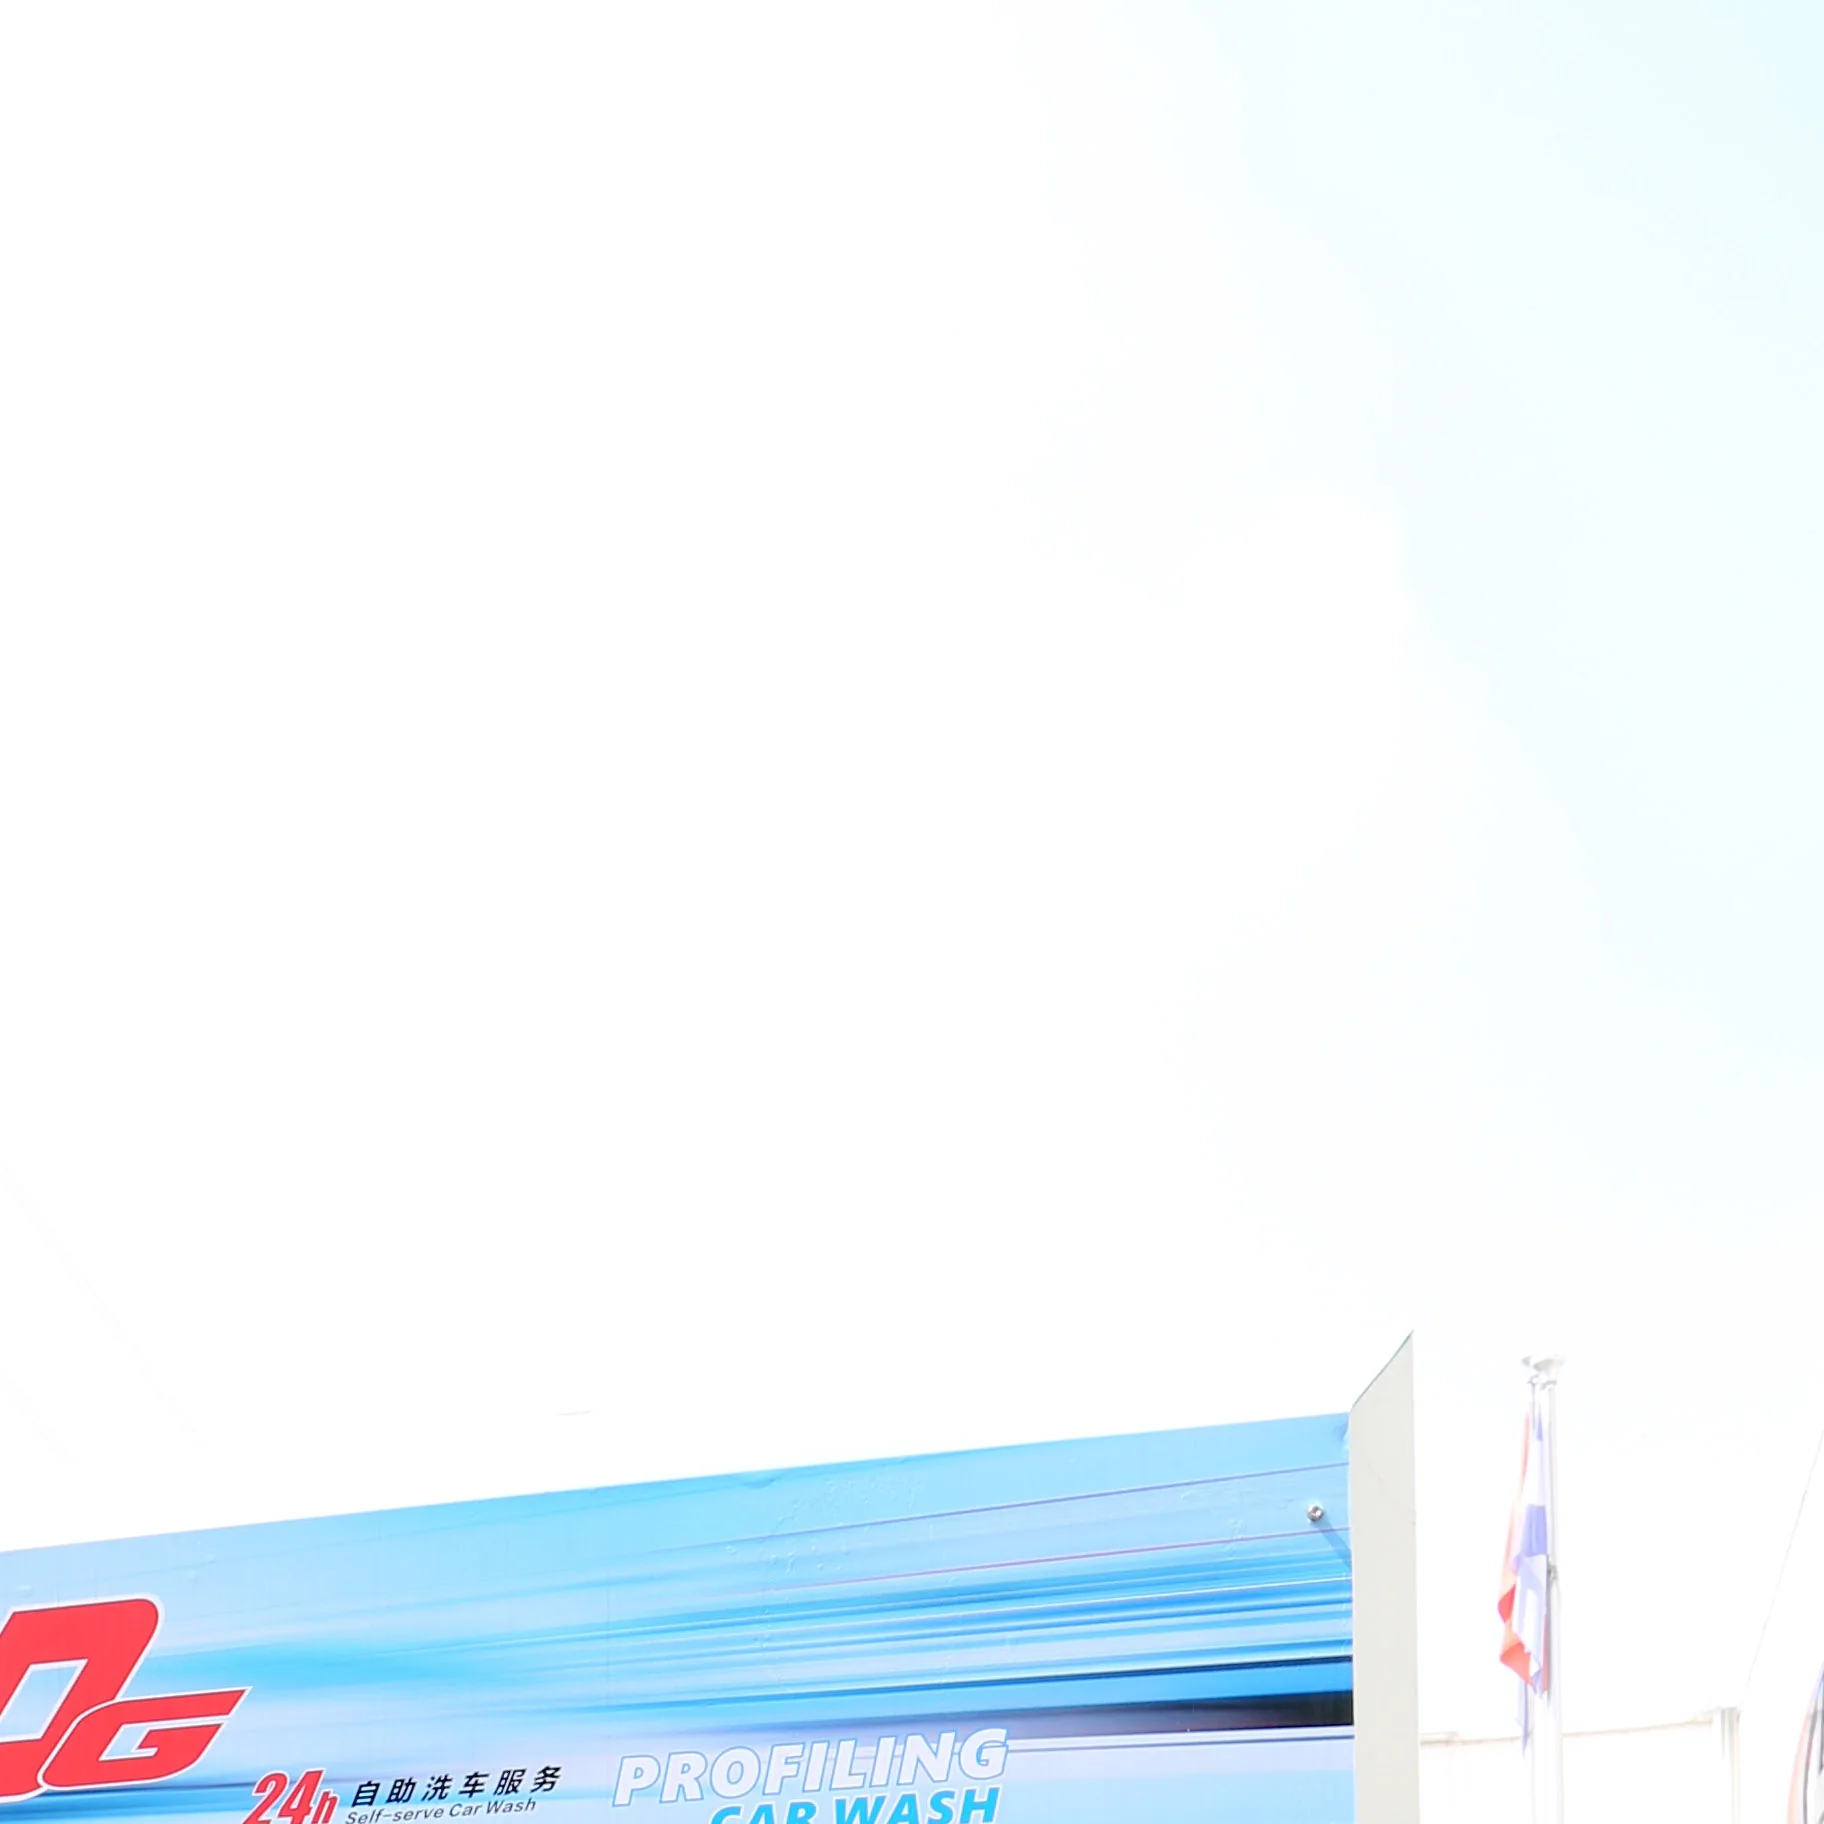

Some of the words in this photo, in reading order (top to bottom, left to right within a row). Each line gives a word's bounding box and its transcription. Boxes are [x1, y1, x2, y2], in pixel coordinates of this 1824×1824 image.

[351, 1765, 563, 1808] 自助洗车服务
[613, 1728, 1010, 1808] PROFILING
[448, 1801, 482, 1818] Car
[485, 1797, 538, 1815] Wash
